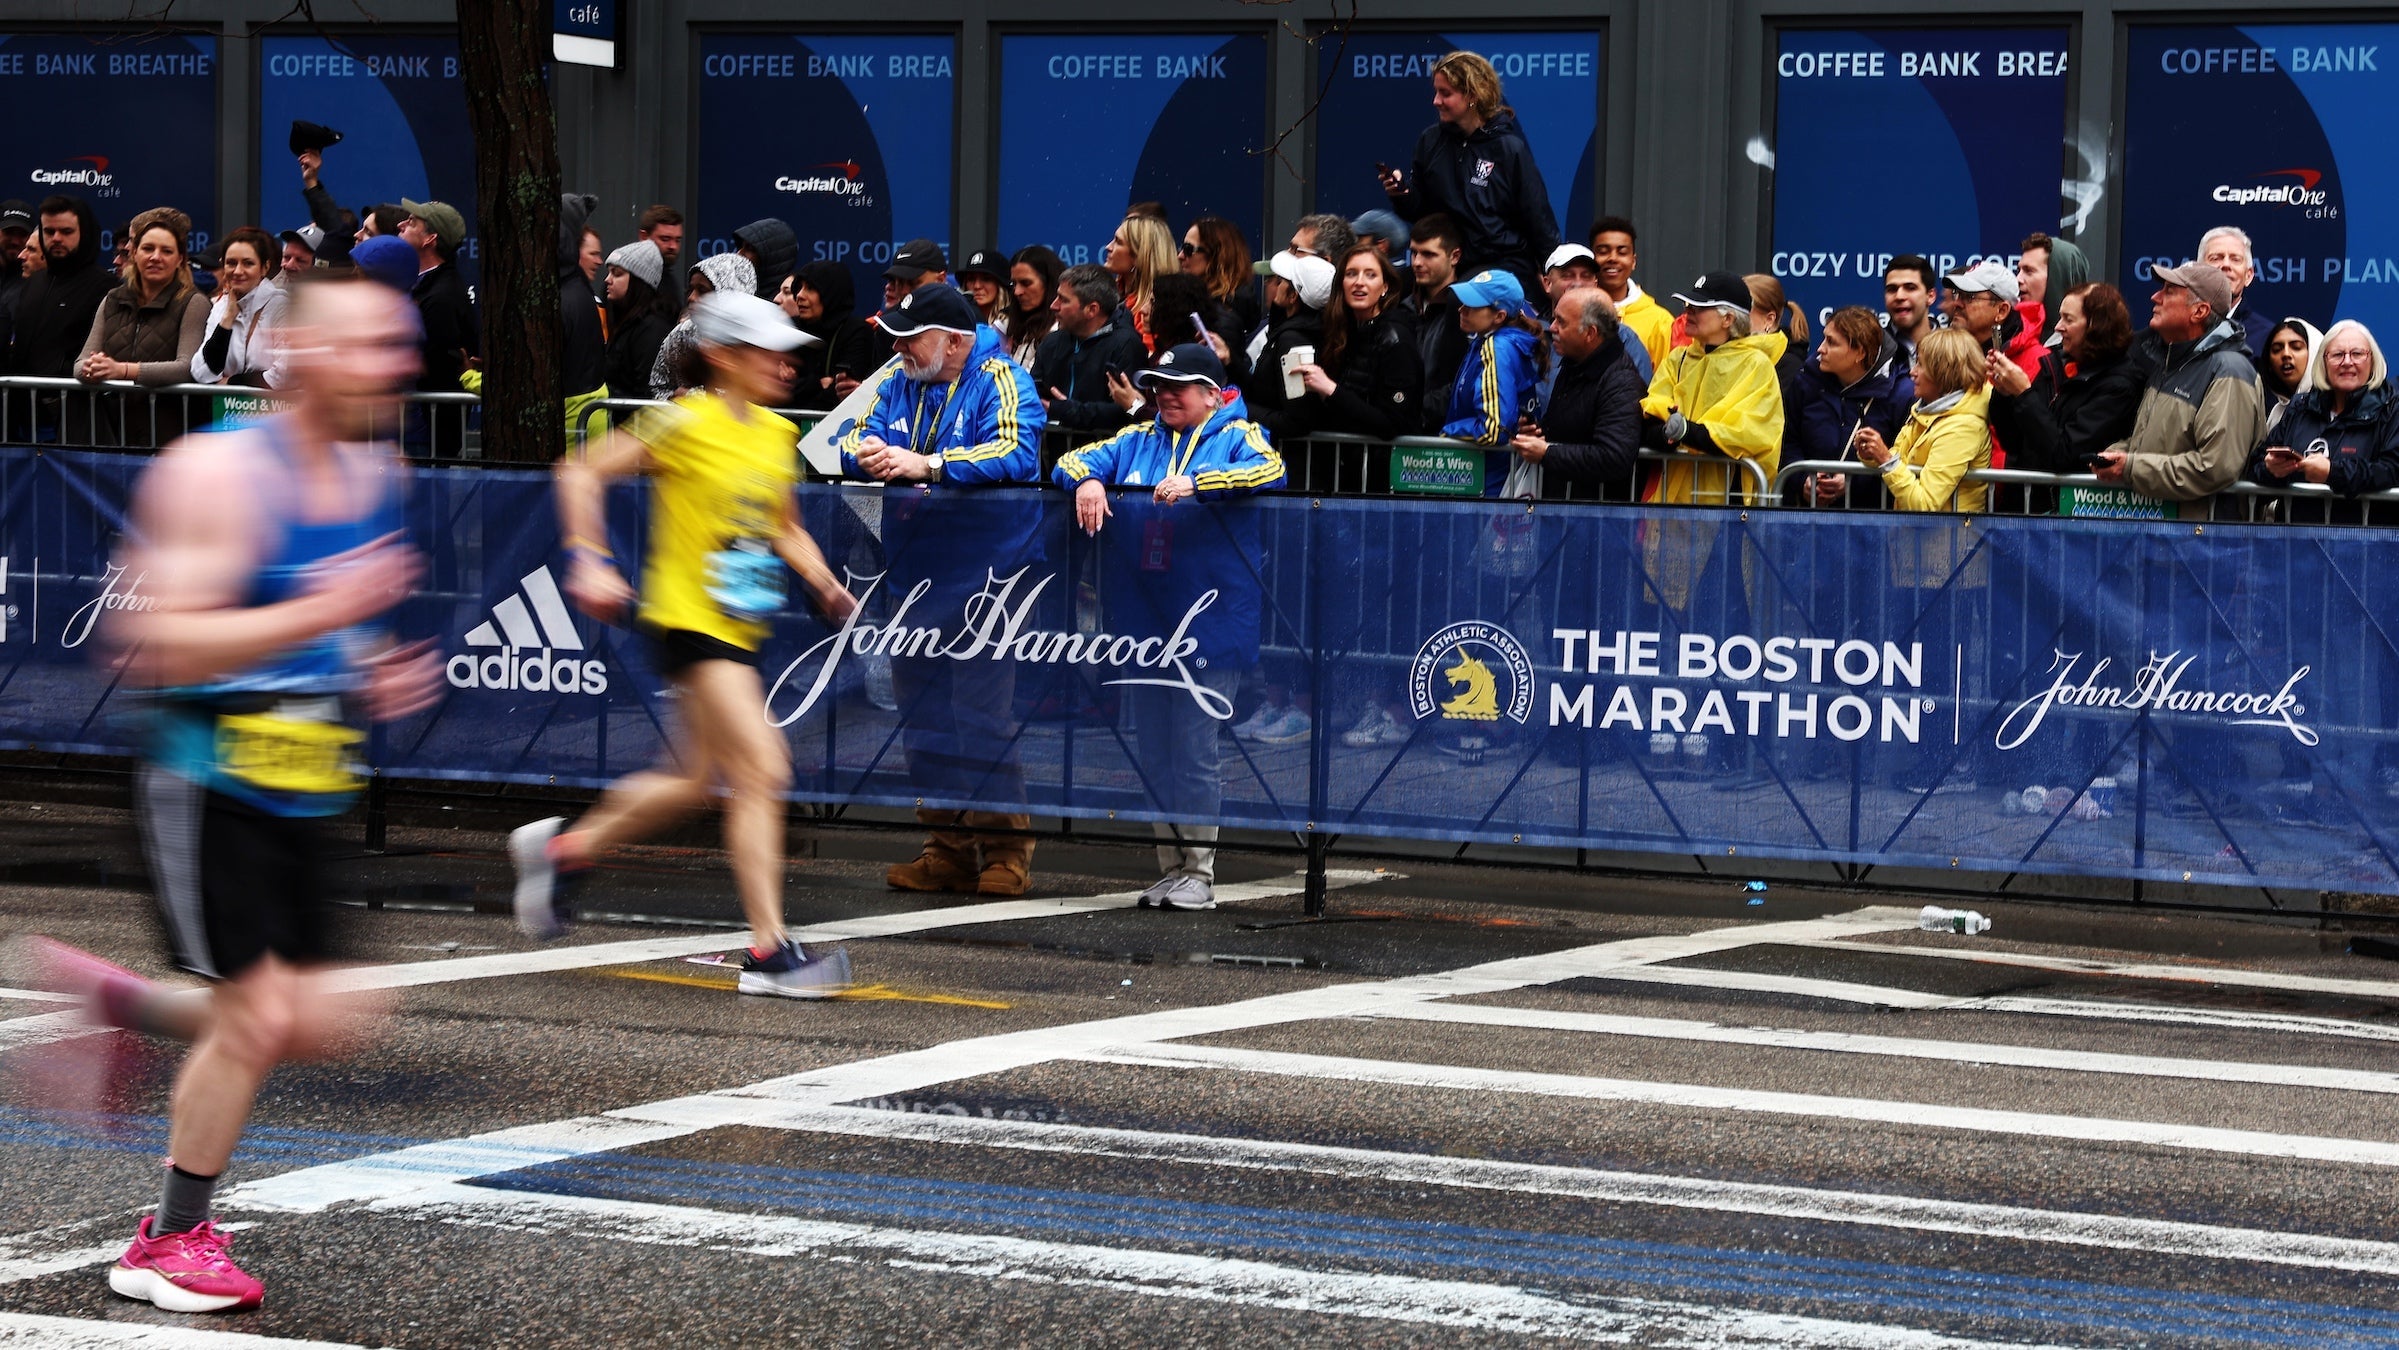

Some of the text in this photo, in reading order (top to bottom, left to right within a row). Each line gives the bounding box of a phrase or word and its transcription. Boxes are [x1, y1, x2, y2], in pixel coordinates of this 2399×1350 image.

[569, 4, 600, 25] café
[36, 55, 96, 75] BANK
[109, 55, 209, 76] BREATHE
[270, 54, 355, 77] COFFEE
[366, 55, 431, 78] BANK
[705, 54, 795, 77] COFFEE
[808, 55, 874, 78] BANK
[1048, 55, 1227, 79] COFFEE BANK
[1353, 53, 1590, 79] BREAT COFFEE
[1777, 52, 1885, 78] COFFEE
[1900, 52, 1981, 77] BANK
[2161, 46, 2378, 74] COFFEE BANK
[847, 194, 874, 208] café
[2305, 206, 2338, 219] café
[812, 240, 851, 264] SIP
[1771, 251, 1848, 279] COZY
[223, 396, 257, 411] Wood
[260, 398, 269, 412] &
[1402, 455, 1473, 471] Wood & Wire
[2073, 487, 2113, 504] Wood
[2116, 490, 2127, 505] &
[61, 561, 164, 649] John
[763, 565, 1234, 729] John Hancock
[1552, 628, 1923, 689] THE BOSTON
[446, 645, 609, 697] adidas
[1415, 625, 1530, 718] BOSTON ATHLETIC ASSOCIATION
[1995, 647, 2320, 750] John Hancock
[1549, 682, 1921, 744] MARATHON
